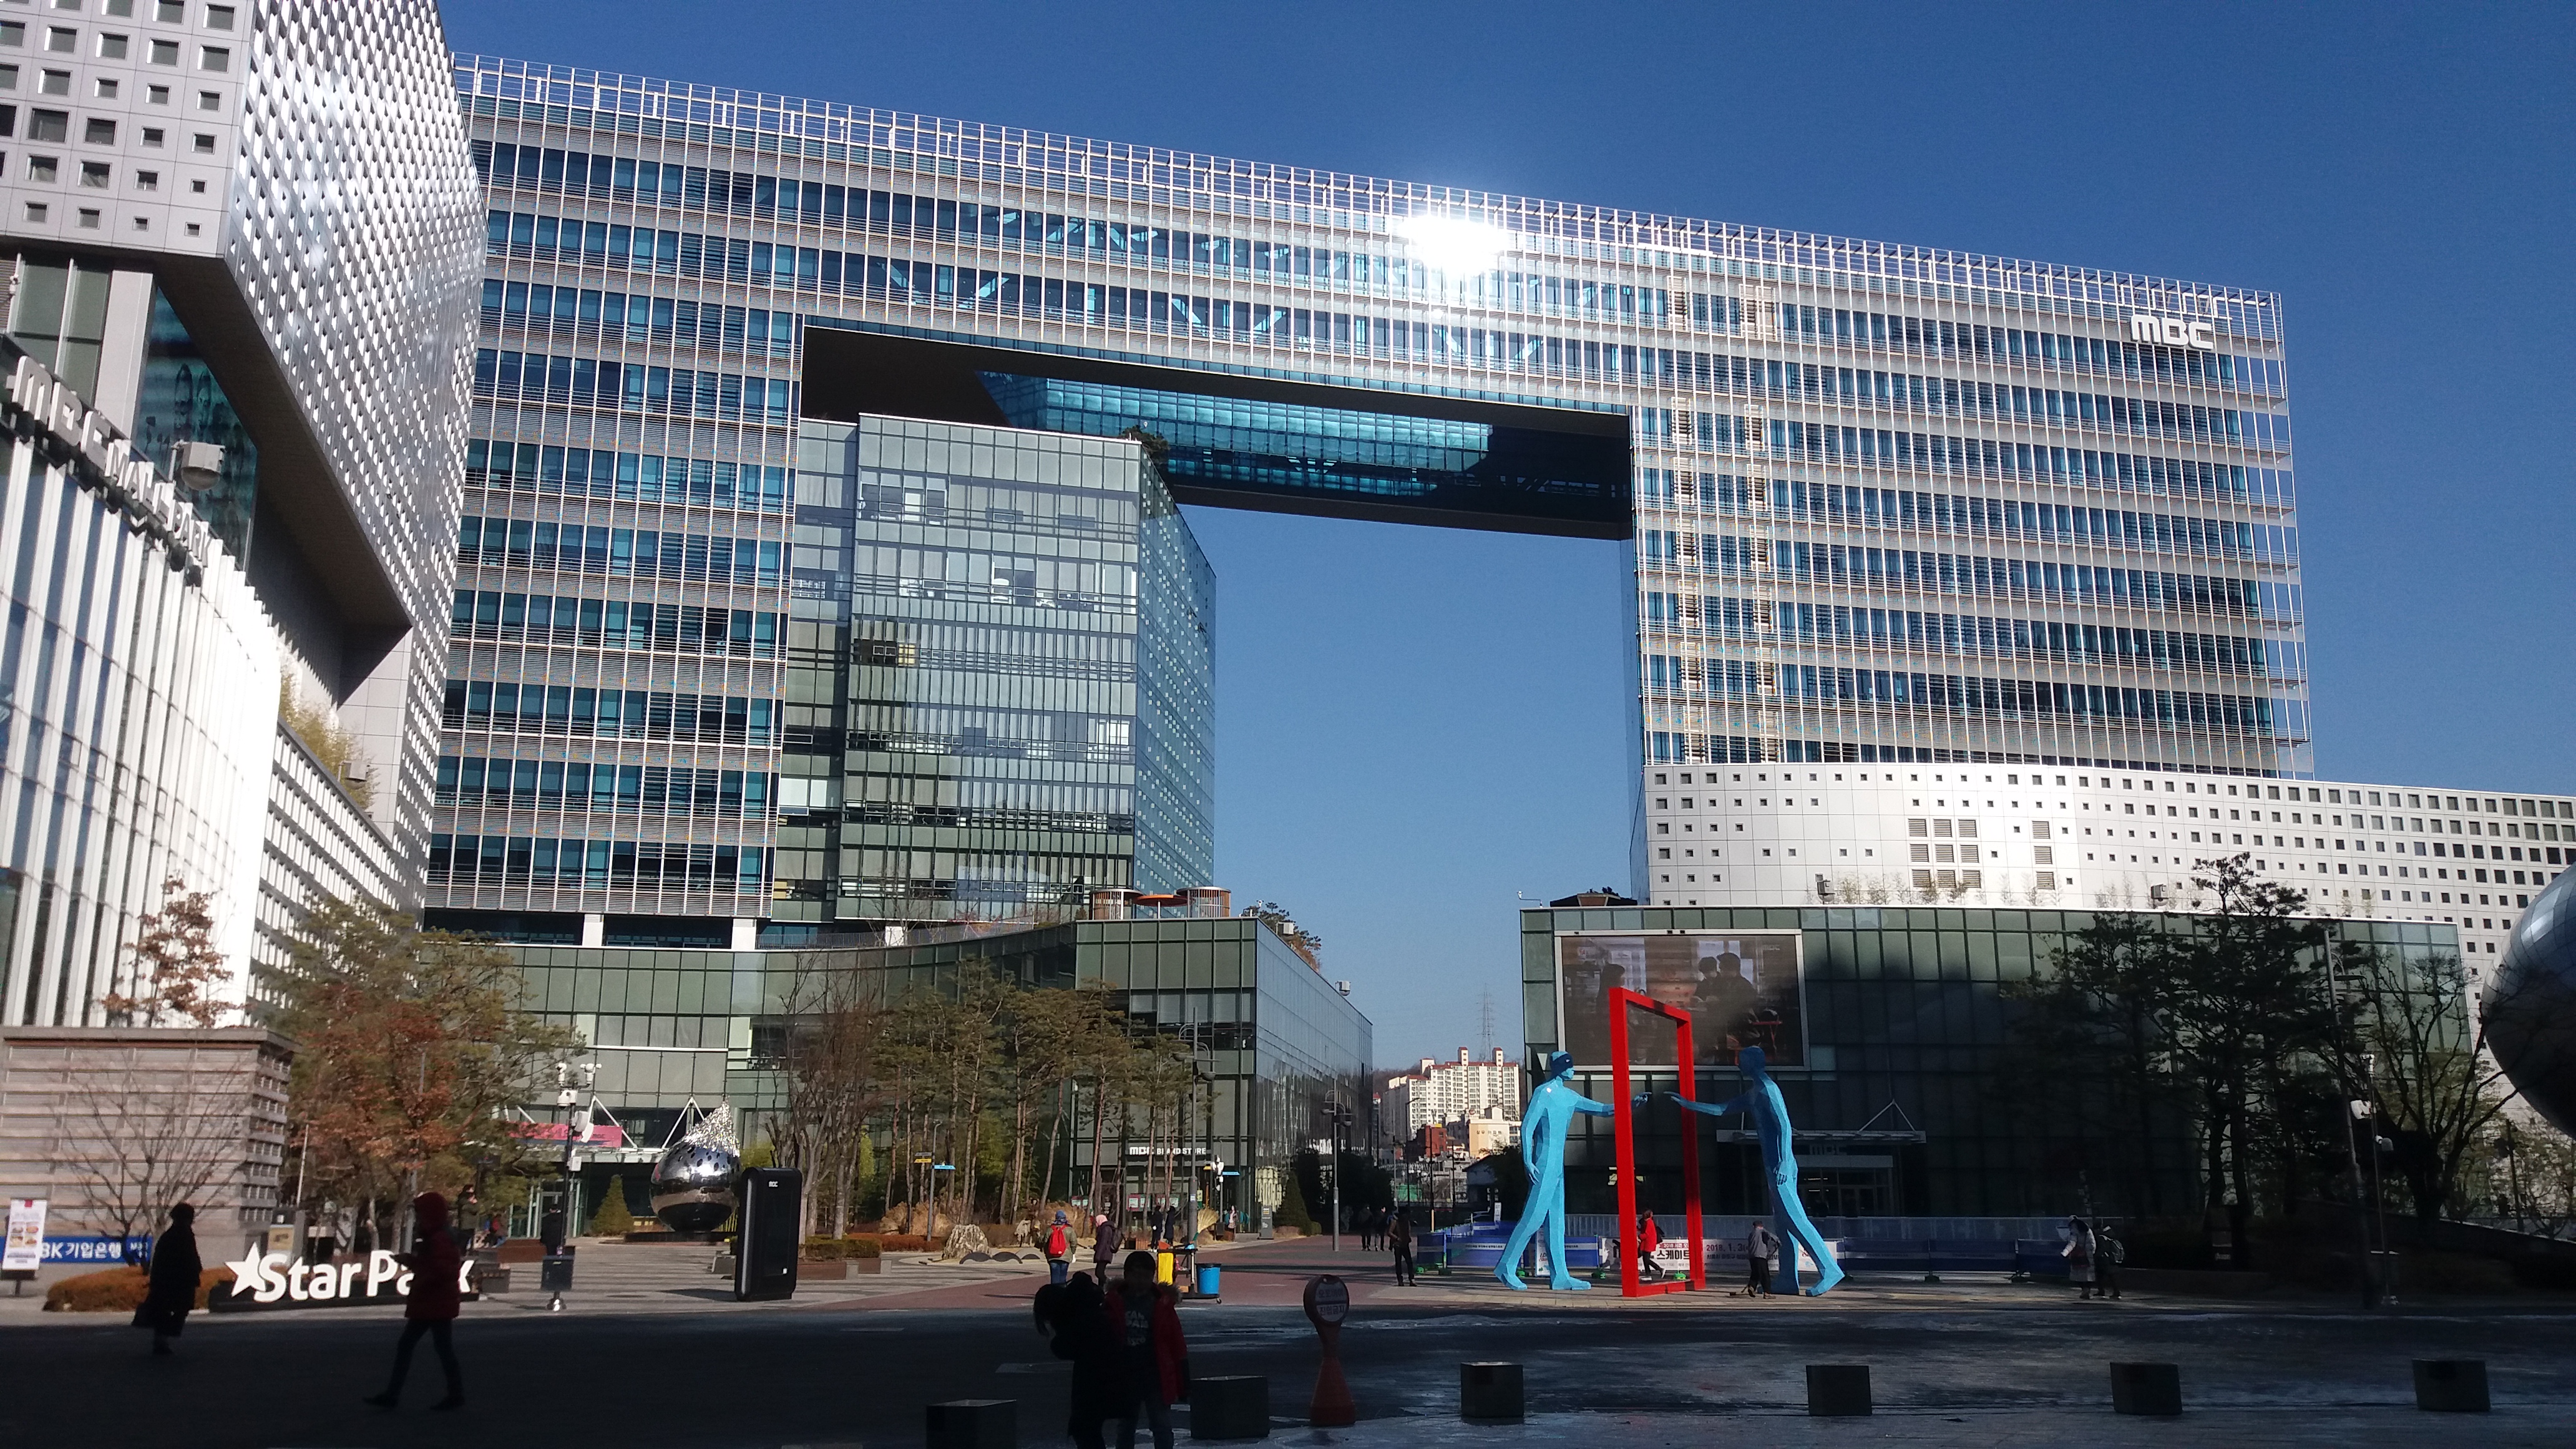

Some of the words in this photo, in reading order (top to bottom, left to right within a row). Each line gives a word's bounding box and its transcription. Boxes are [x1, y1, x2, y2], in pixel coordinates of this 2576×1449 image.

[2130, 315, 2214, 350] MBC
[11, 355, 111, 472] MBC
[166, 499, 212, 568] PARK
[1129, 1146, 1154, 1155] MBC
[40, 1242, 64, 1259] BK
[65, 1241, 122, 1259] 기업은행
[1656, 1249, 1690, 1260] 스케이트
[253, 1252, 362, 1303] Star
[366, 1249, 474, 1297] Pk
[1319, 1305, 1345, 1316] 진입금지
